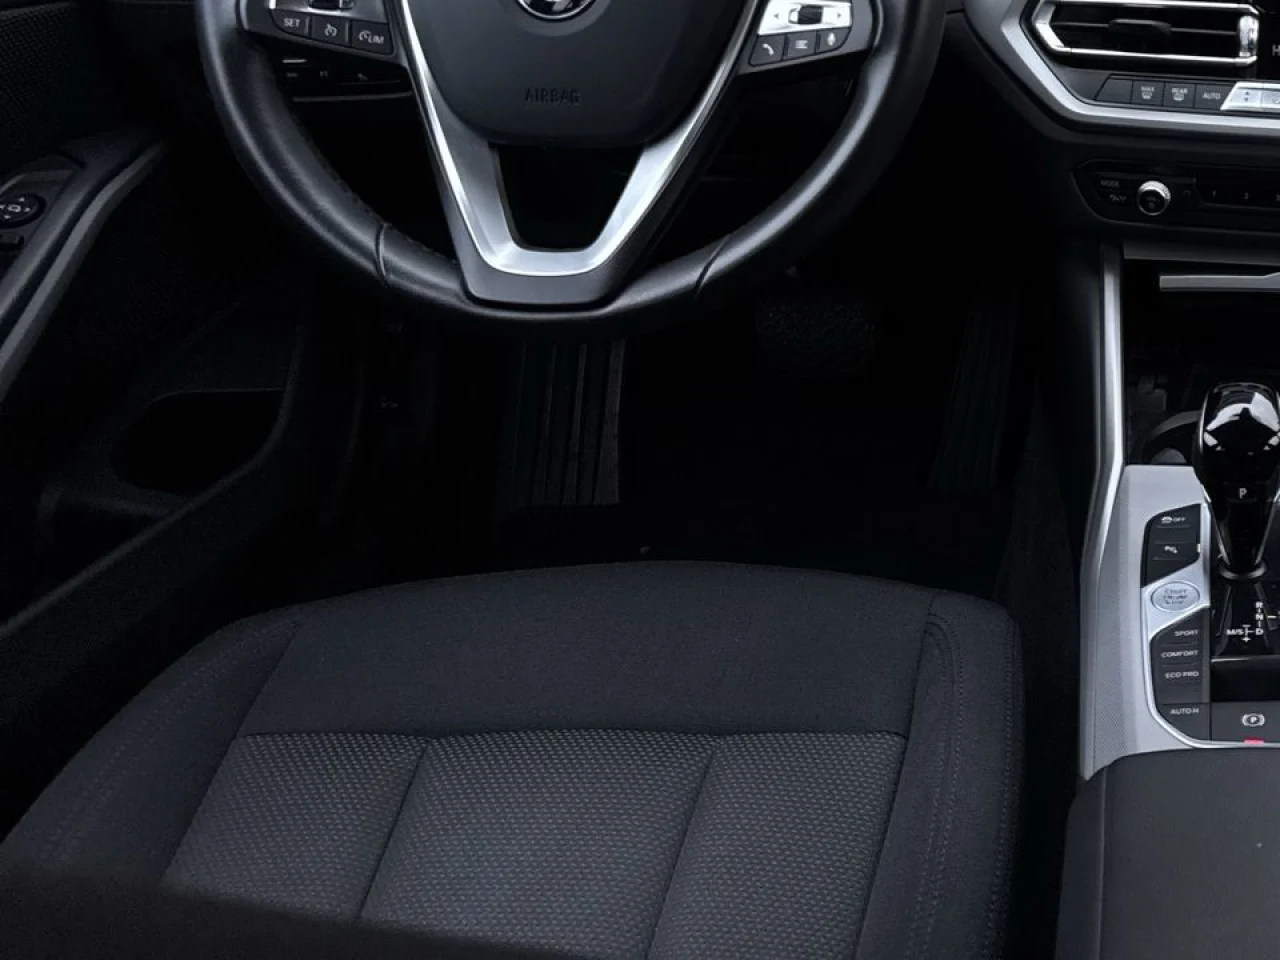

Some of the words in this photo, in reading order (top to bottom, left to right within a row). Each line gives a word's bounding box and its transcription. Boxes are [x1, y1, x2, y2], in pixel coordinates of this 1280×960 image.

[284, 18, 301, 28] SET
[368, 35, 385, 44] LIM
[525, 87, 580, 103] AIRBAG
[1202, 92, 1221, 100] AUTO
[1239, 487, 1247, 499] P
[1174, 629, 1199, 637] SPORT
[1161, 650, 1199, 658] COMFORT
[1165, 671, 1182, 679] ECO
